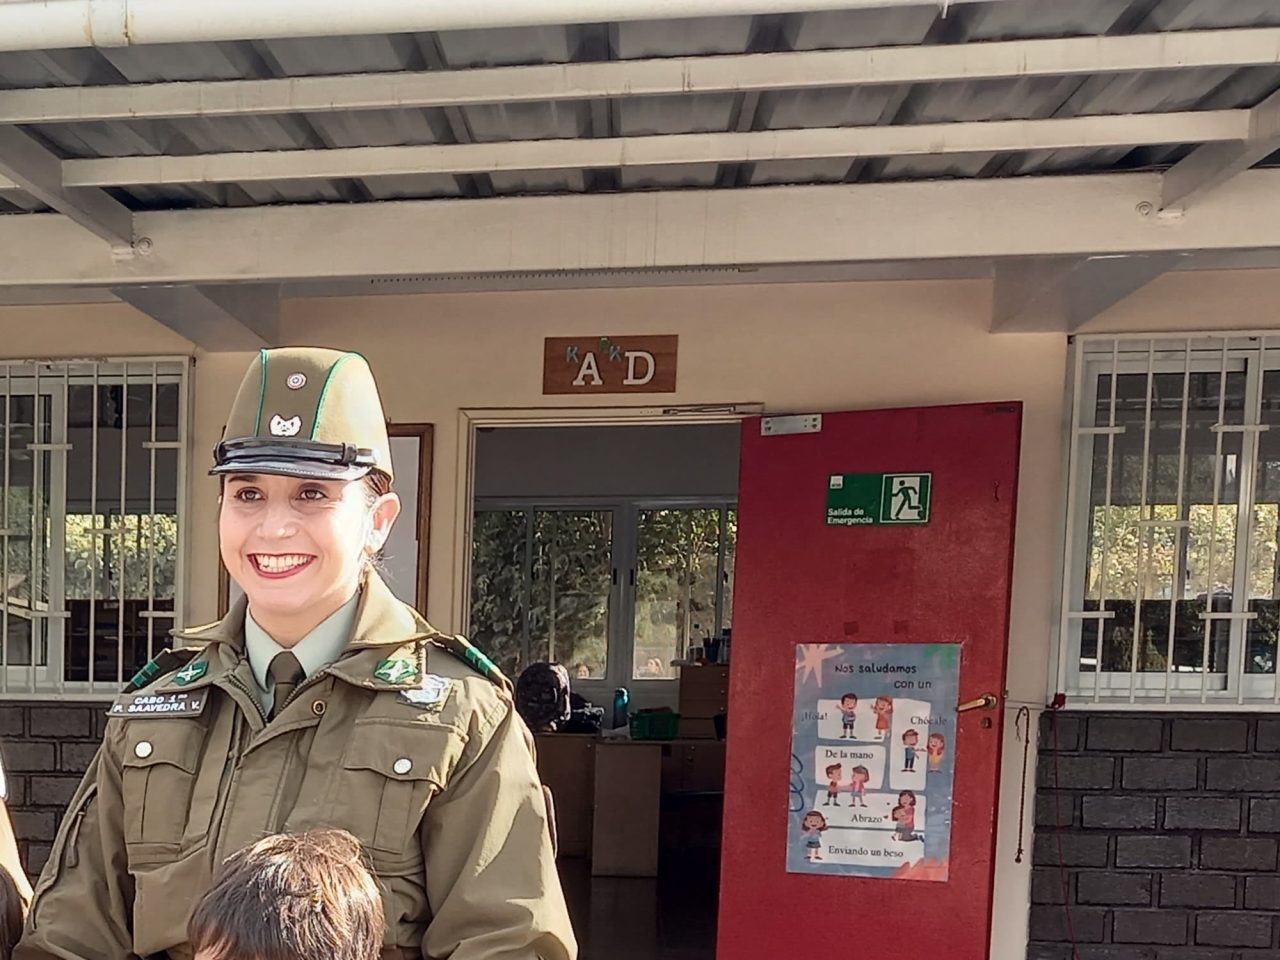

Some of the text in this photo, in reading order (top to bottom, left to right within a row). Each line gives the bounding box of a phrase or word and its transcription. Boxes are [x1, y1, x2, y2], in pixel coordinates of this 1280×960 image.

[572, 352, 603, 386] A
[623, 351, 656, 385] D
[828, 507, 865, 516] Salida de
[827, 516, 874, 526] Emergencia
[835, 662, 917, 674] Nos saludamos
[894, 680, 932, 689] con un
[134, 696, 165, 705] CABO
[128, 701, 186, 713] SAAVEDRA
[825, 749, 874, 760] De la mano
[851, 814, 882, 824] Abrazo
[828, 845, 904, 858] Enviando un beso
